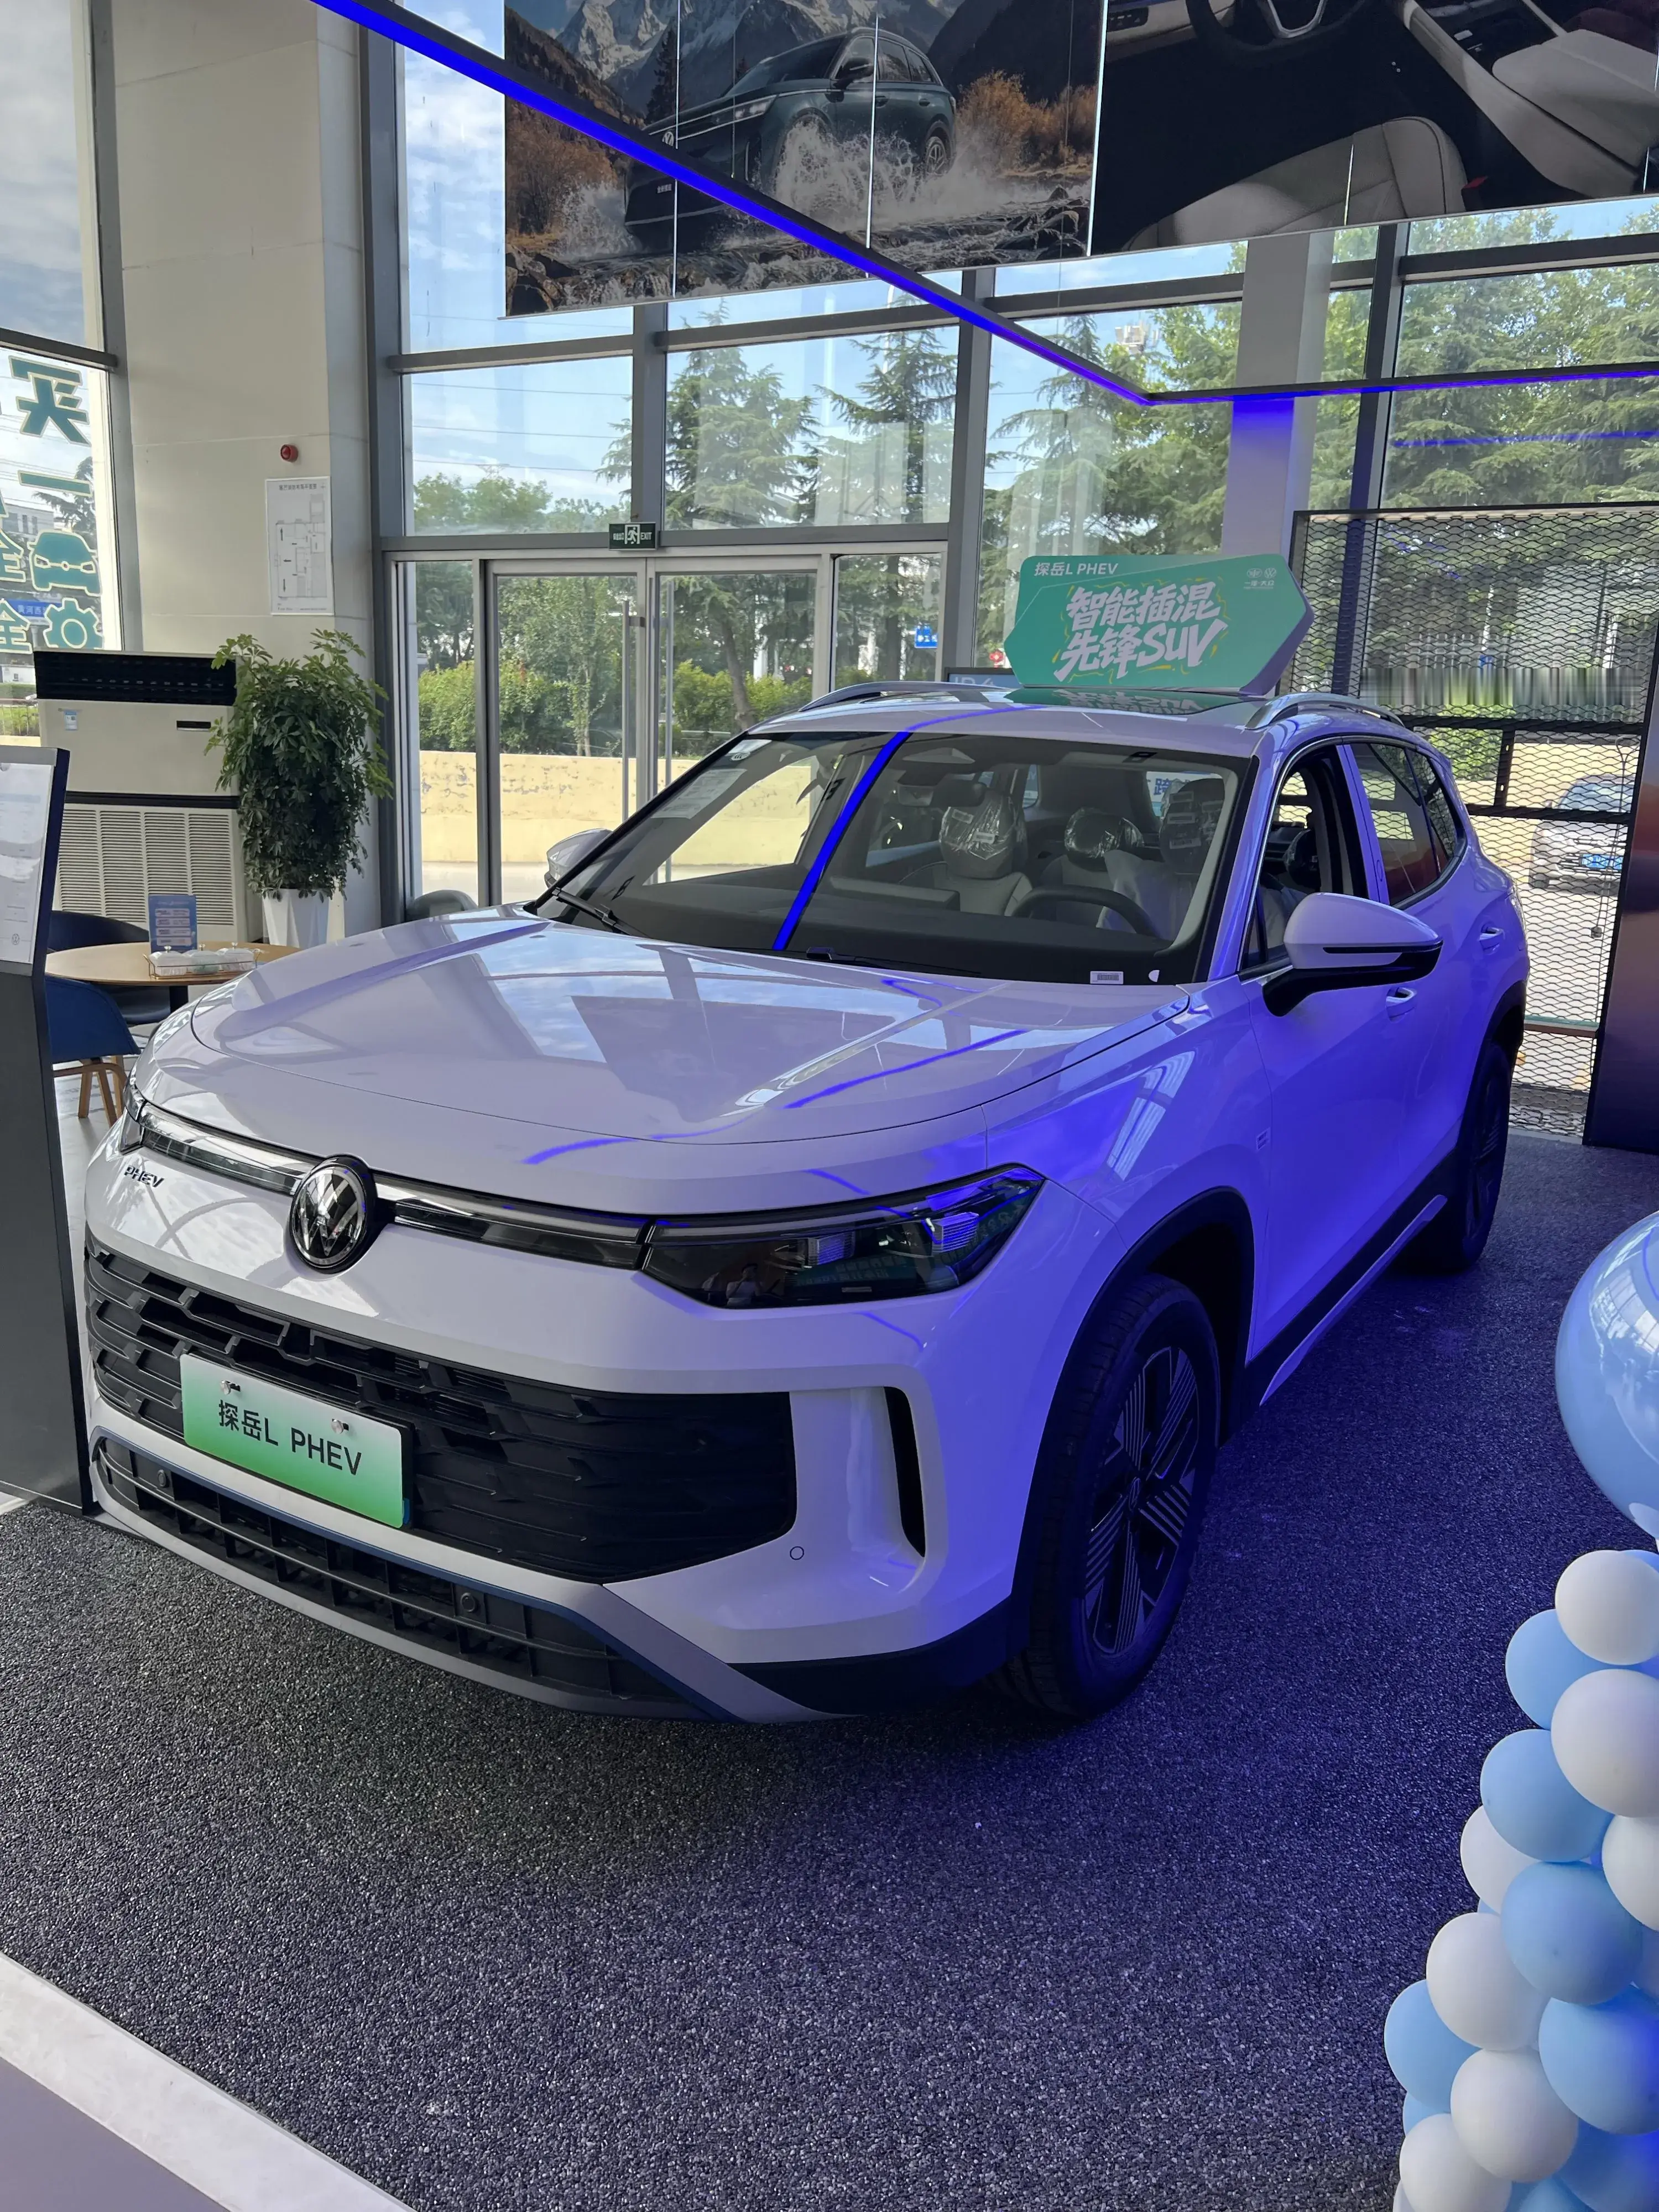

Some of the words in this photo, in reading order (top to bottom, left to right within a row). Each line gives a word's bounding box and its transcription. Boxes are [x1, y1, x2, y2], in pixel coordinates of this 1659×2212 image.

[640, 532, 652, 540] EXIT
[1034, 562, 1073, 576] 探岳L
[1077, 563, 1119, 575] PHEV
[17, 604, 46, 615] 黄河西
[1066, 581, 1221, 631] 智能插混
[1053, 618, 1229, 682] 先锋SUV
[124, 1165, 165, 1188] PHEV
[219, 1400, 278, 1446] 探岳L
[291, 1427, 362, 1475] PHEV
